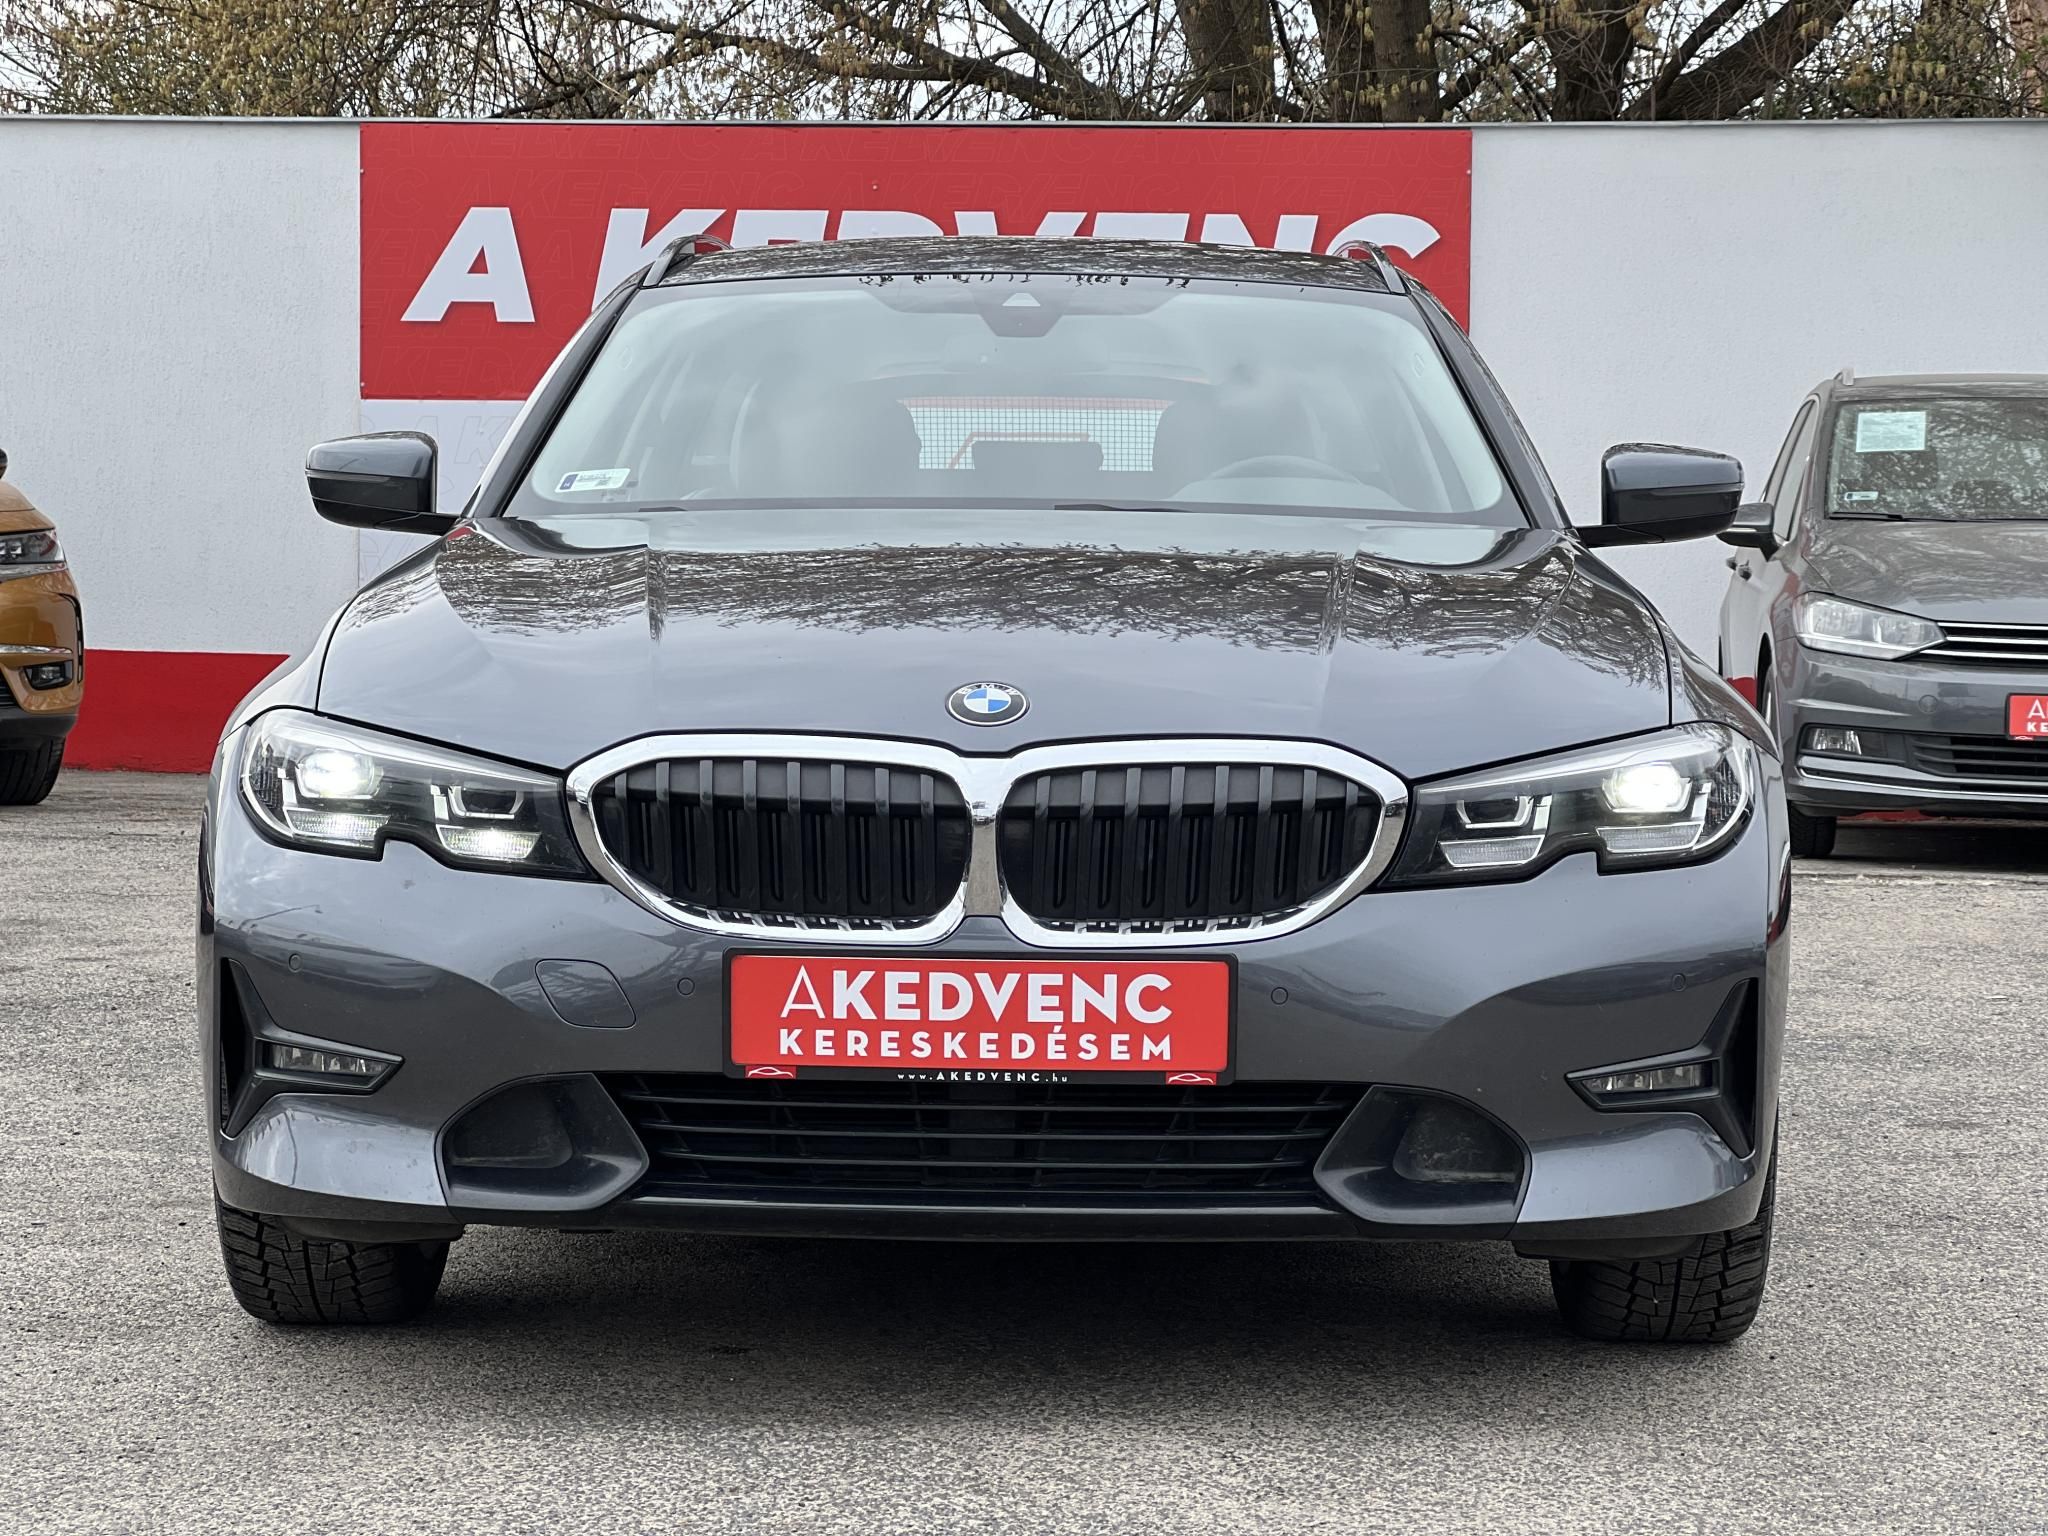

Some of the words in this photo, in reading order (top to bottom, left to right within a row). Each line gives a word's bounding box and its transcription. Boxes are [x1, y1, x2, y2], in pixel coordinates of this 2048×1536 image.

[401, 206, 536, 323] A
[779, 1026, 1171, 1061] KERESKEDÉSEM
[897, 1071, 1068, 1083] www.AKEDVENC.hu
